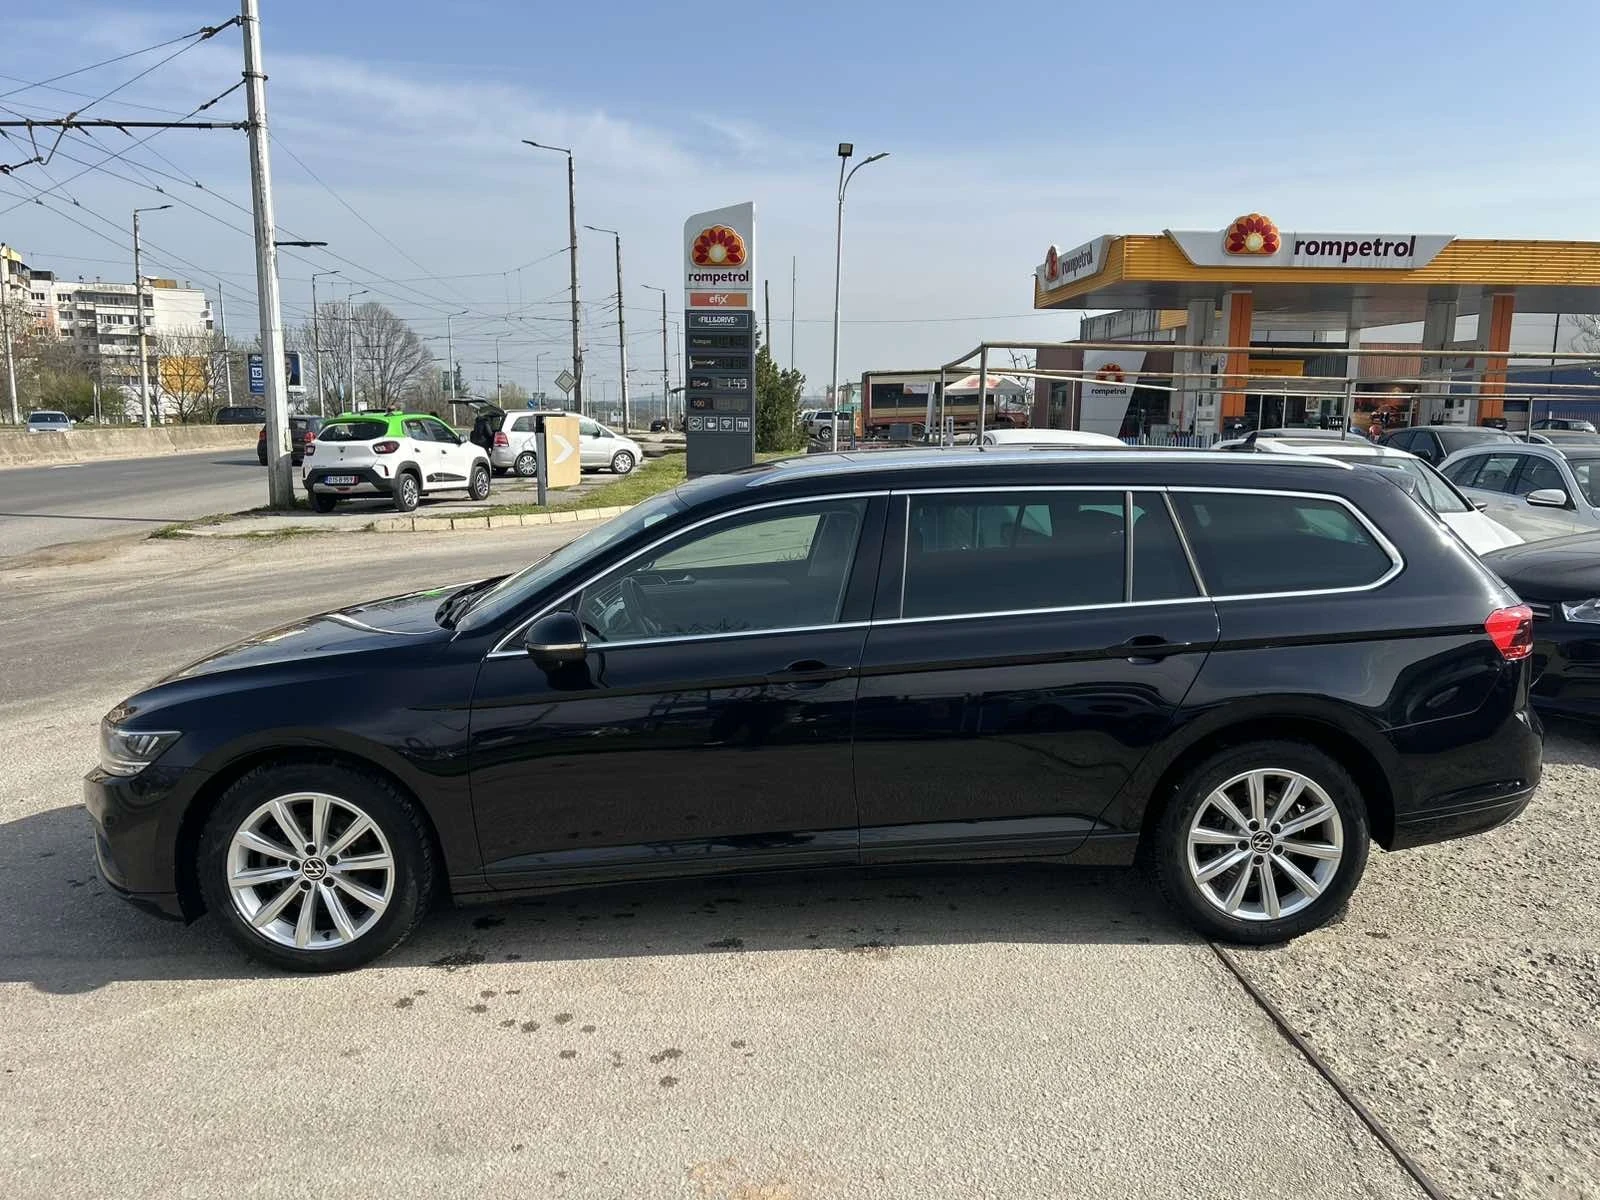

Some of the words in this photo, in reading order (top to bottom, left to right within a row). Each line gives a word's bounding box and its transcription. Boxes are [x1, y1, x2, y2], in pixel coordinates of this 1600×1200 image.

[1294, 235, 1416, 263] rompetrol
[1062, 243, 1093, 277] rompetrol
[688, 270, 749, 285] rompetrol
[709, 294, 729, 305] efix
[253, 369, 261, 377] 15
[1091, 387, 1127, 396] rompetrol
